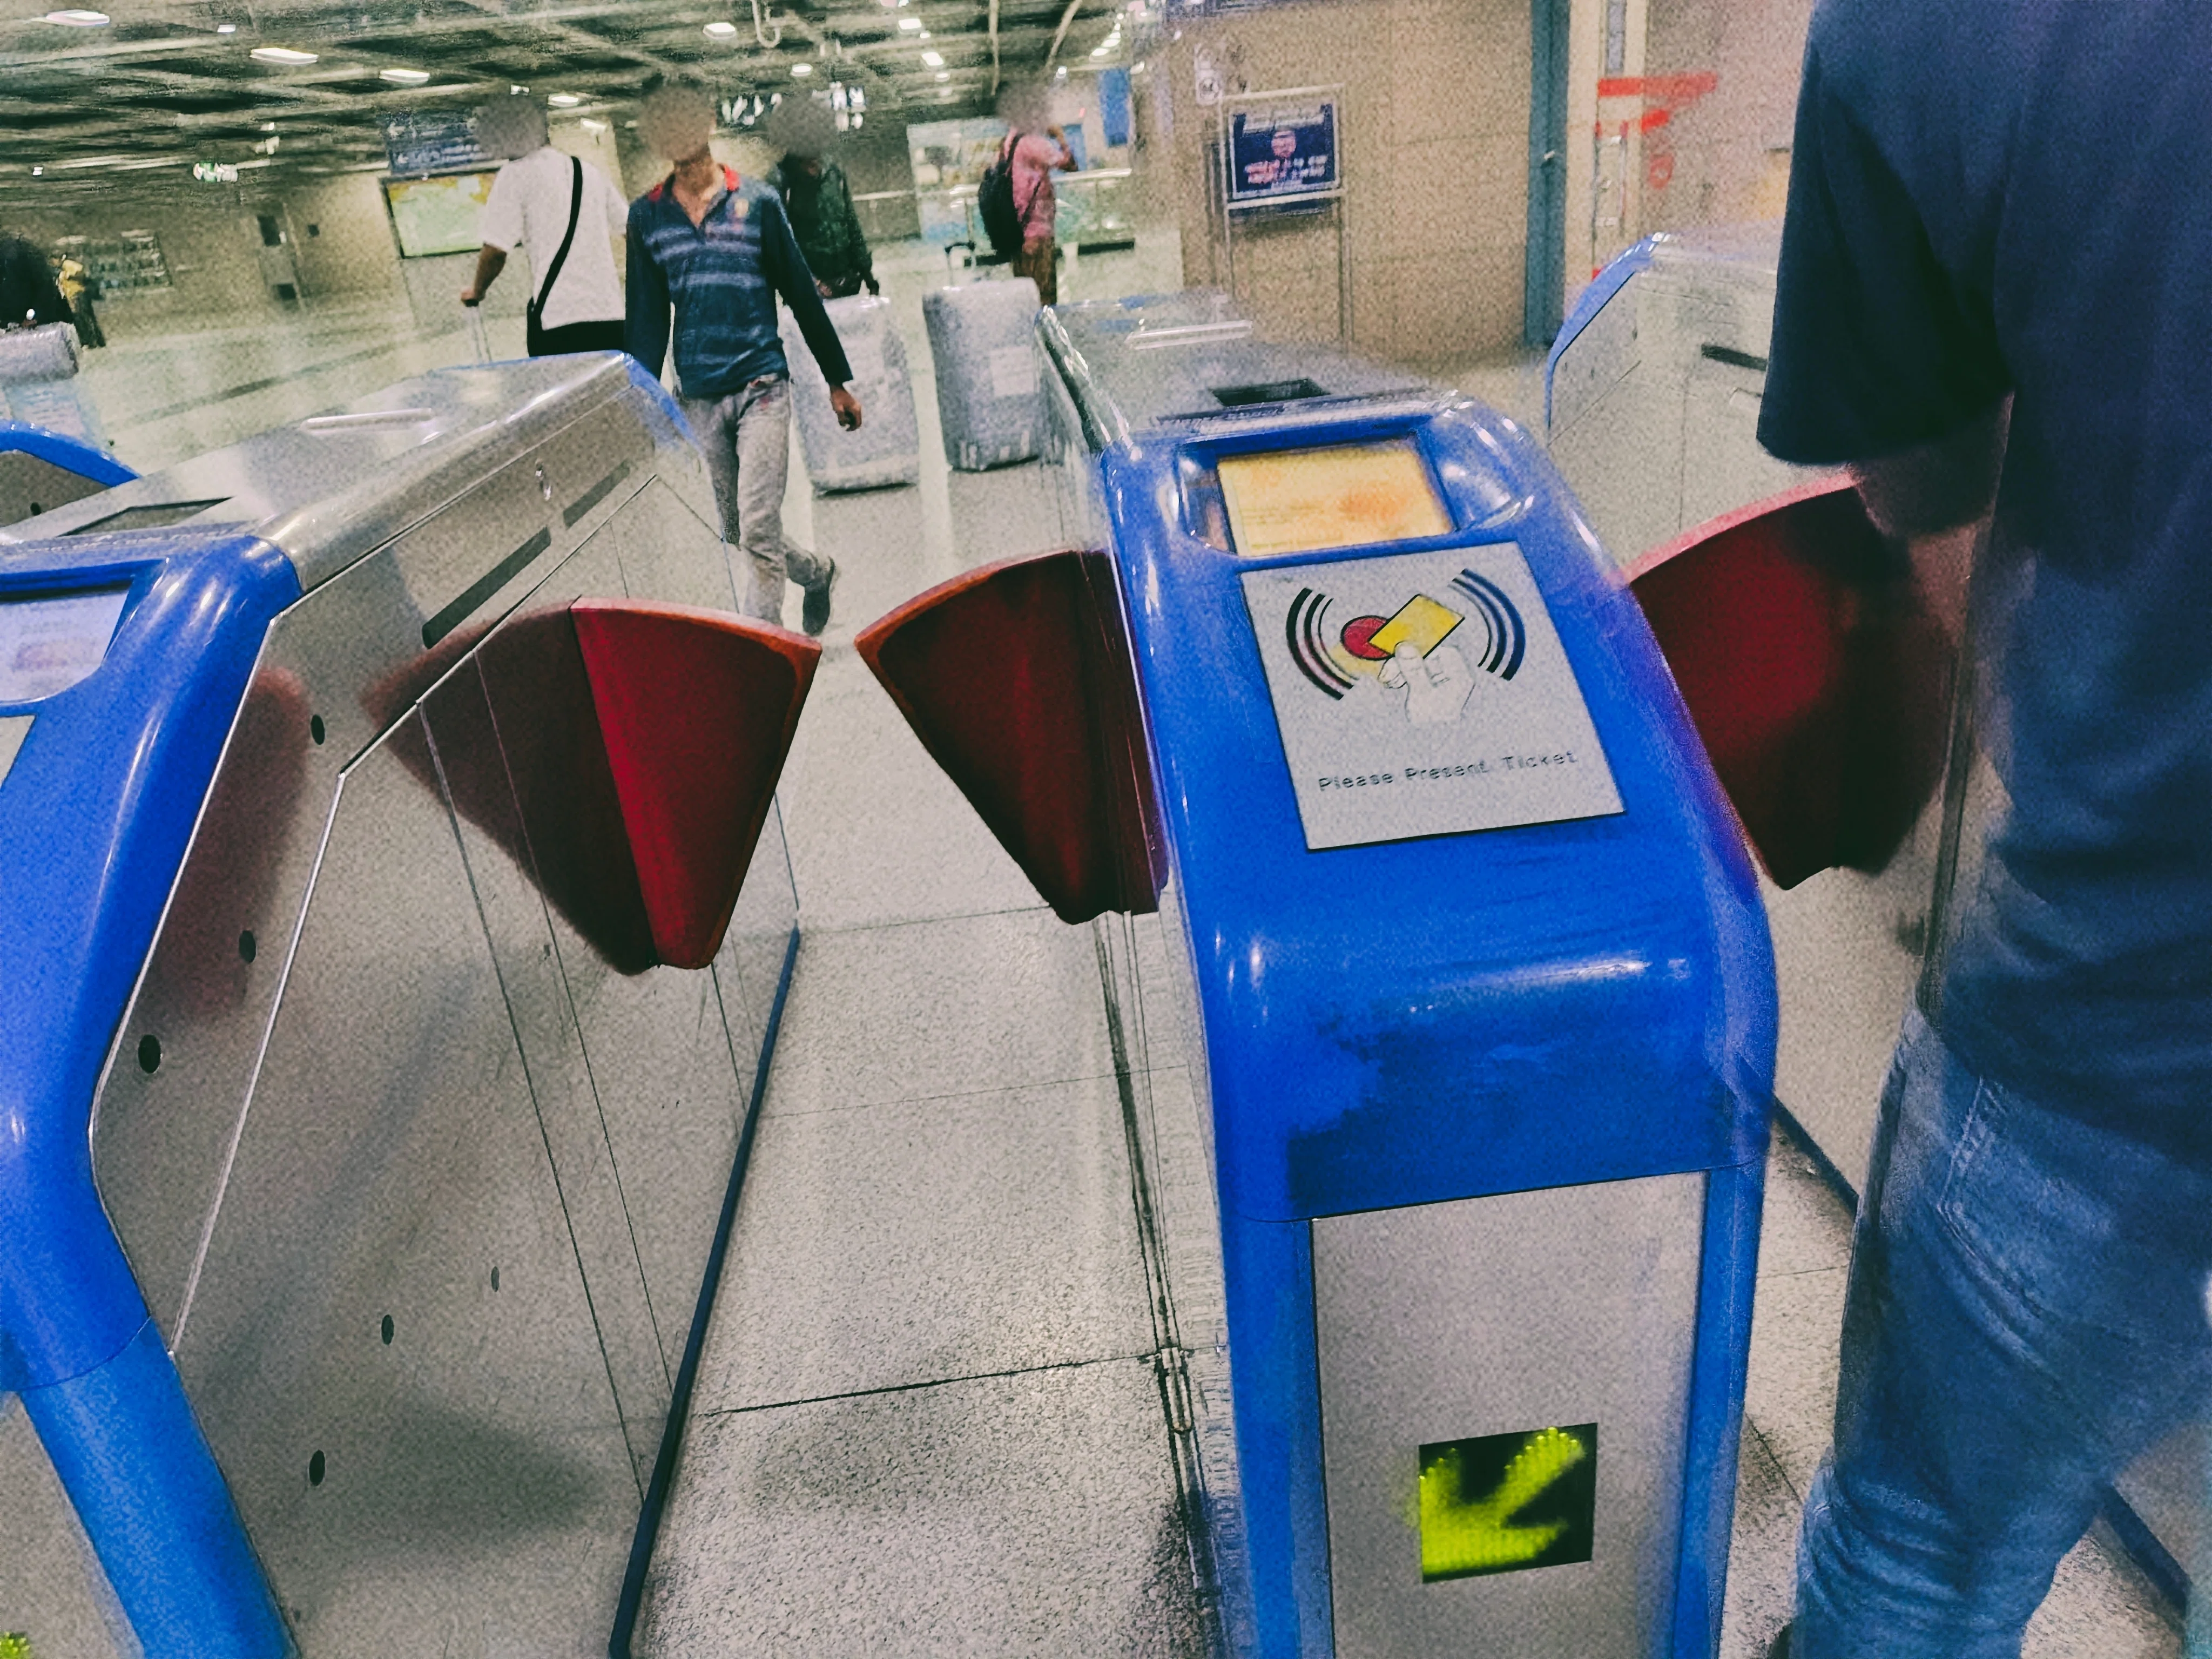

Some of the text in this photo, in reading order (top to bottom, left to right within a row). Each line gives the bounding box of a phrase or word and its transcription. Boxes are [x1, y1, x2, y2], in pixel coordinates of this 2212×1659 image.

[1318, 750, 1578, 792] Please Present Ticket
